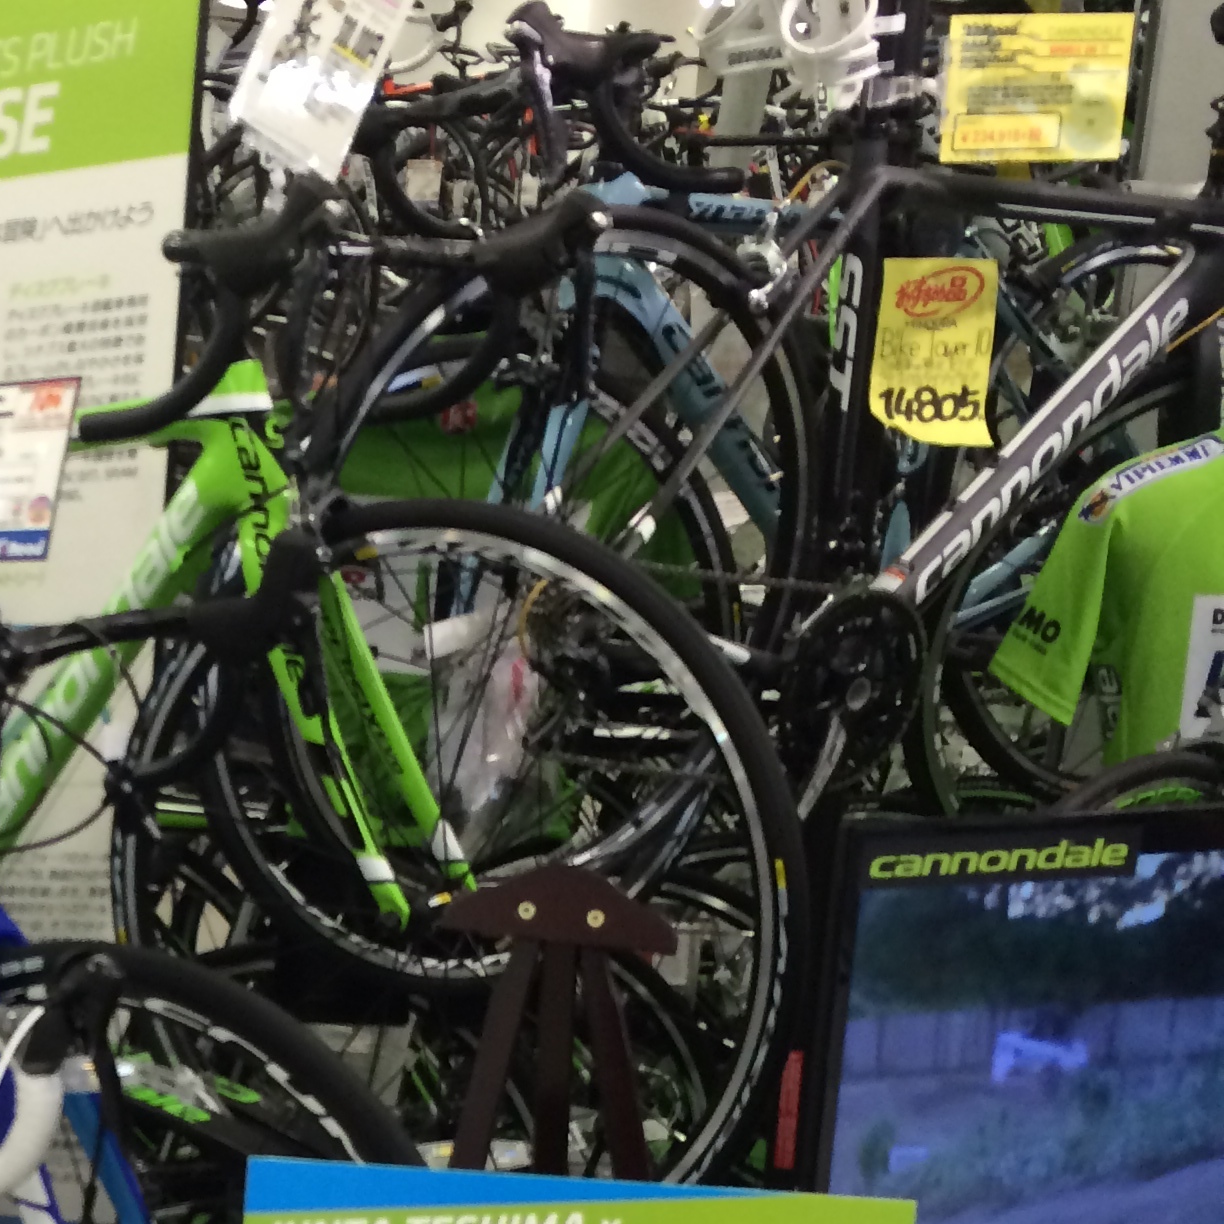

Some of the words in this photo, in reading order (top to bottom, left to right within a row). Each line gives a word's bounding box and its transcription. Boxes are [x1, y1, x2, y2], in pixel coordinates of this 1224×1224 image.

[27, 17, 139, 72] PLUSH
[879, 384, 981, 423] 14805
[916, 297, 1190, 605] cannondale
[869, 838, 1130, 879] cannondale
